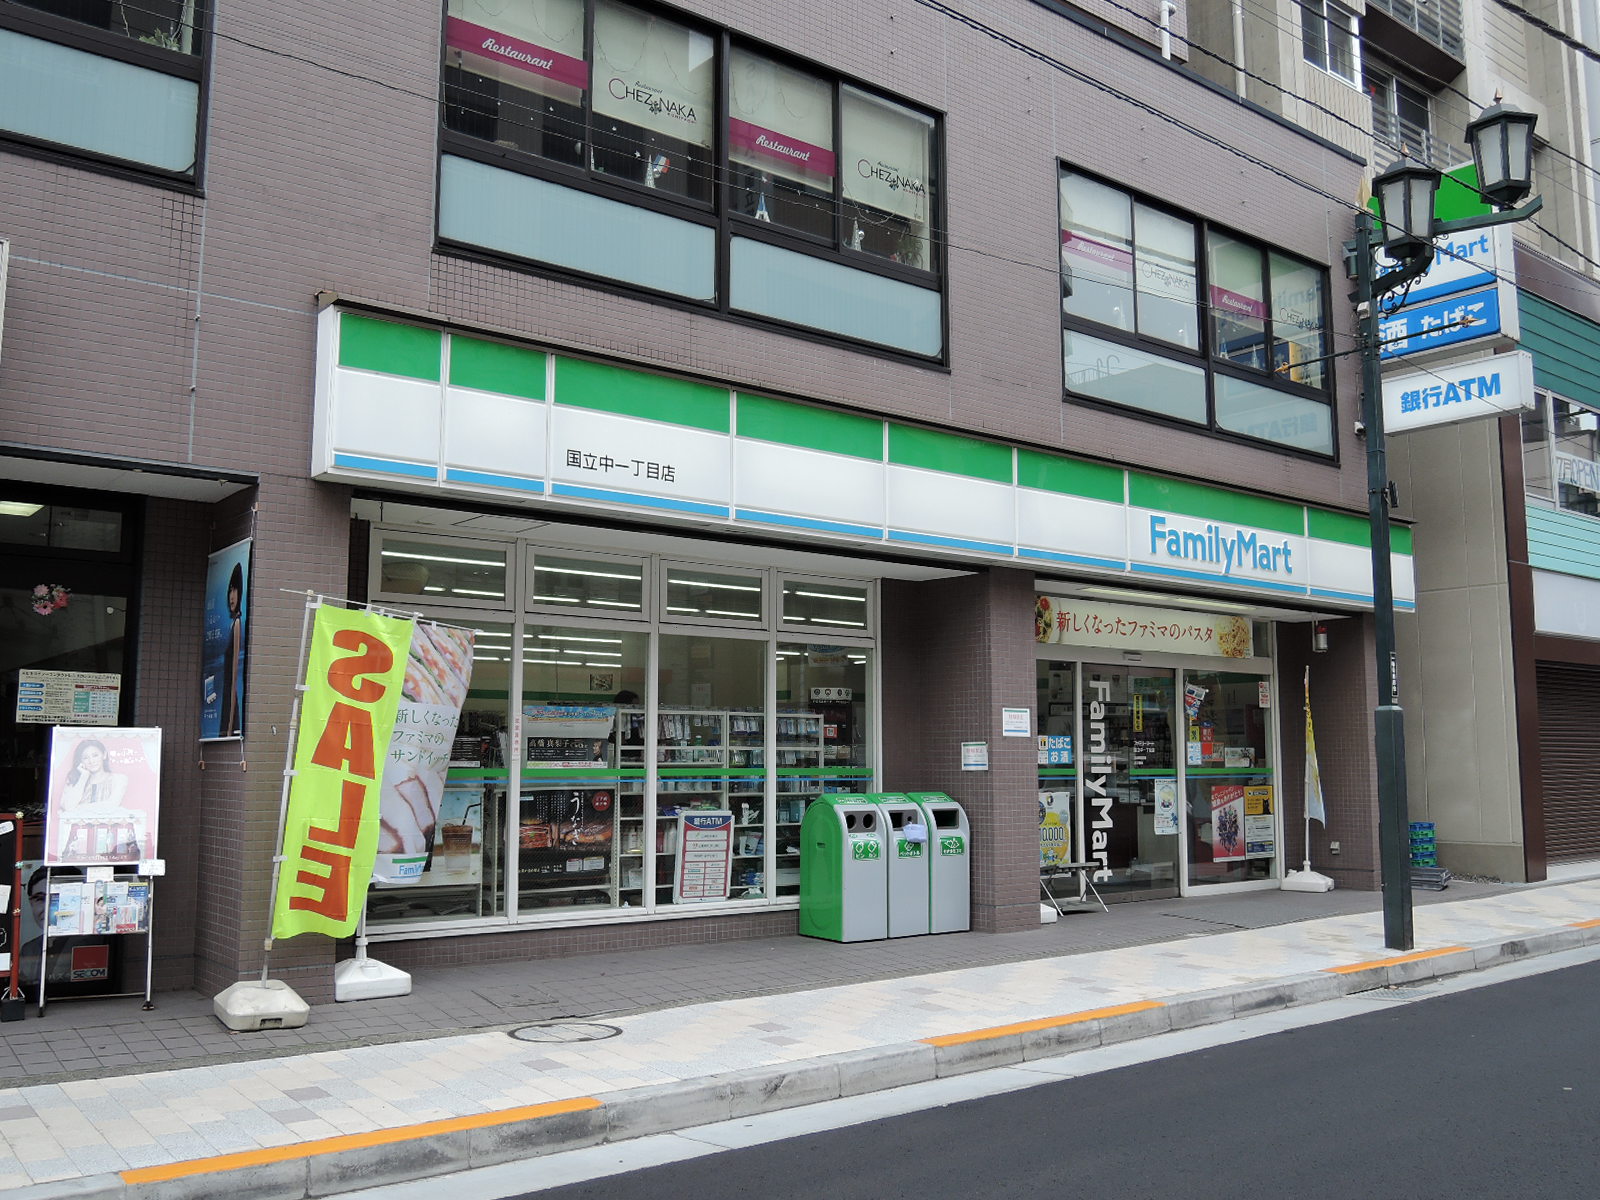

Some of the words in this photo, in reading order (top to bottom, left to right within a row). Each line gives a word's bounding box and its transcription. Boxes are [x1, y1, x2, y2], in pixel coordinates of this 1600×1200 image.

[481, 38, 553, 70] Restaurant
[608, 77, 653, 107] CHEZ
[659, 97, 697, 121] NAKA
[755, 134, 810, 161] Restaurant
[857, 158, 893, 183] CHEZ
[1379, 318, 1409, 352] 酒
[1420, 301, 1488, 340] たばこ
[1400, 373, 1501, 414] 銀行ATM
[566, 449, 676, 482] 国立中一丁目店
[1150, 514, 1293, 575] FamilyMart
[1056, 610, 1213, 643] 新しくなったファミマのパスタ
[393, 730, 445, 747] ファミマの
[1048, 736, 1071, 749] たばこ
[391, 748, 449, 766] サンドイッチ
[1050, 751, 1069, 763] お酒
[1085, 680, 1113, 883] FamilyMart
[73, 968, 106, 979] SECOM
